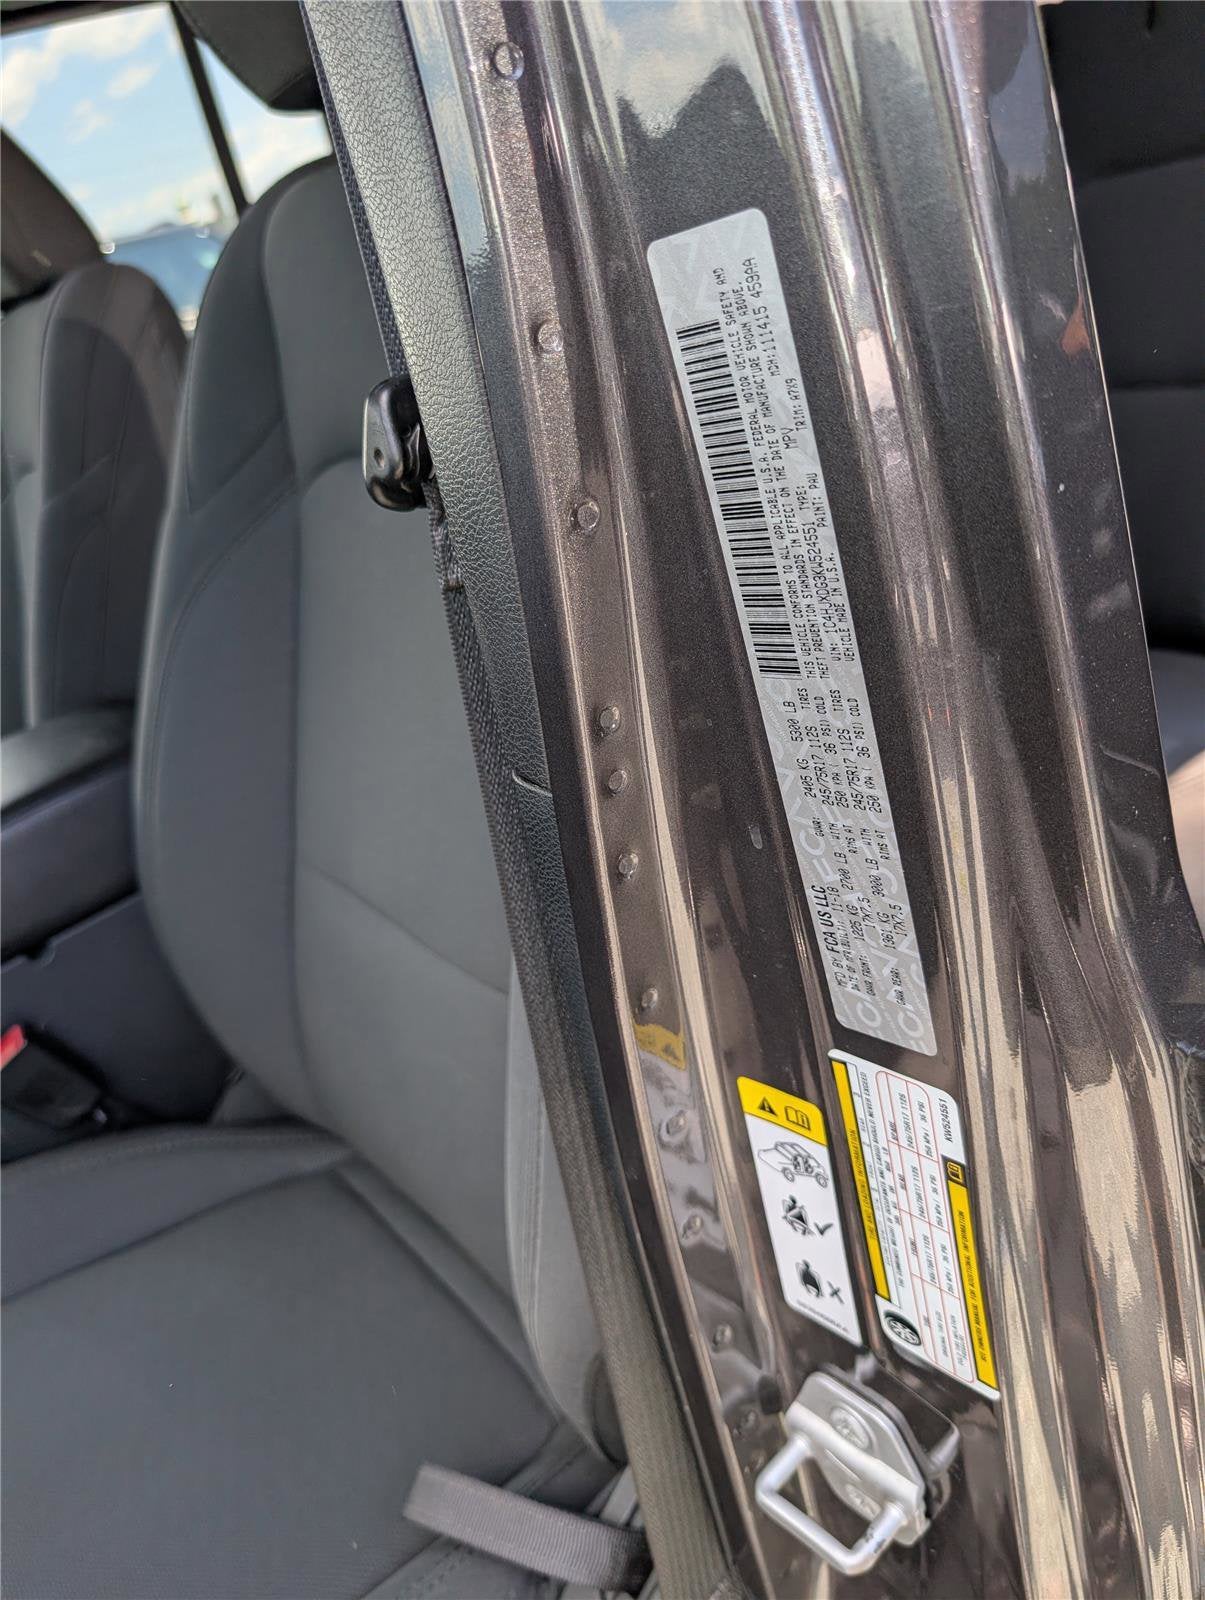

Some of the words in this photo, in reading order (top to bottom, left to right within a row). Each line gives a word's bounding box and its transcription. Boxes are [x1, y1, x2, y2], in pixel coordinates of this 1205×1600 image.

[711, 265, 727, 287] AND
[740, 255, 764, 300] 459AA
[717, 288, 737, 326] SAFETY
[729, 280, 750, 318] ABOVE.
[739, 320, 757, 351] SHOWN
[726, 329, 747, 372] VEHICLE
[737, 373, 755, 404] MOTOR
[746, 354, 773, 418] MANUFACTURE
[745, 407, 765, 447] FEDERAL
[763, 421, 777, 434] OF
[779, 425, 799, 450] MPV
[766, 437, 783, 460] DATE
[755, 451, 774, 484] U.S.A.
[772, 464, 787, 482] THE
[804, 471, 820, 489] PAU
[777, 485, 791, 498] ON
[793, 484, 810, 511] TYPE:
[763, 487, 786, 540] APPLICABLE
[781, 502, 799, 534] EFFECT
[809, 495, 828, 528] PAINT:
[776, 544, 791, 560] ALL
[789, 537, 802, 548] IN
[781, 564, 794, 574] TO
[792, 553, 813, 599] STANDARDS
[800, 520, 838, 634] 1C4HJXDG3KW524551
[821, 551, 840, 582] U.S.A.
[784, 579, 804, 619] CONFORMS
[829, 586, 843, 596] IN
[832, 601, 849, 623] MADE
[794, 622, 813, 657] VEHICLE
[803, 602, 825, 652] PREVENTION
[827, 641, 843, 662] VIN:
[837, 626, 857, 662] VEHICLE
[802, 659, 818, 679] THIS
[814, 655, 831, 680] THEFT
[781, 699, 797, 714] LB
[796, 686, 811, 710] TIRES
[812, 694, 827, 715] COLD
[828, 688, 844, 713] TIRES
[846, 696, 861, 717] COLD
[785, 716, 804, 743] 5300
[803, 724, 821, 749] 112S
[835, 726, 854, 752] 112S
[822, 741, 838, 755] 36
[854, 744, 871, 759] 36
[795, 756, 810, 771] KG
[799, 773, 817, 799] 2405
[810, 753, 834, 806] 245/75R17
[829, 770, 843, 786] KPA
[842, 756, 867, 812] 245/75R17
[862, 774, 876, 790] KPA
[832, 789, 849, 809] 250
[865, 793, 882, 813] 250
[827, 821, 841, 841] WITH
[842, 823, 854, 834] AT
[859, 826, 873, 847] WITH
[874, 828, 886, 840] AT
[833, 850, 848, 864] LB
[845, 835, 858, 855] RIMS
[877, 841, 891, 861] RIMS
[864, 856, 879, 871] LB
[836, 866, 854, 891] 2700
[867, 873, 885, 898] 3000
[810, 883, 830, 908] LLC
[825, 884, 844, 914] 11-18
[816, 908, 834, 929] US
[845, 902, 860, 917] KG
[856, 895, 876, 929] 17X7.5
[875, 910, 891, 925] KG
[888, 901, 907, 937] 17X7.5
[821, 928, 840, 954] FCA
[848, 917, 865, 942] 1225
[879, 926, 896, 951] 1361
[830, 955, 844, 969] BY
